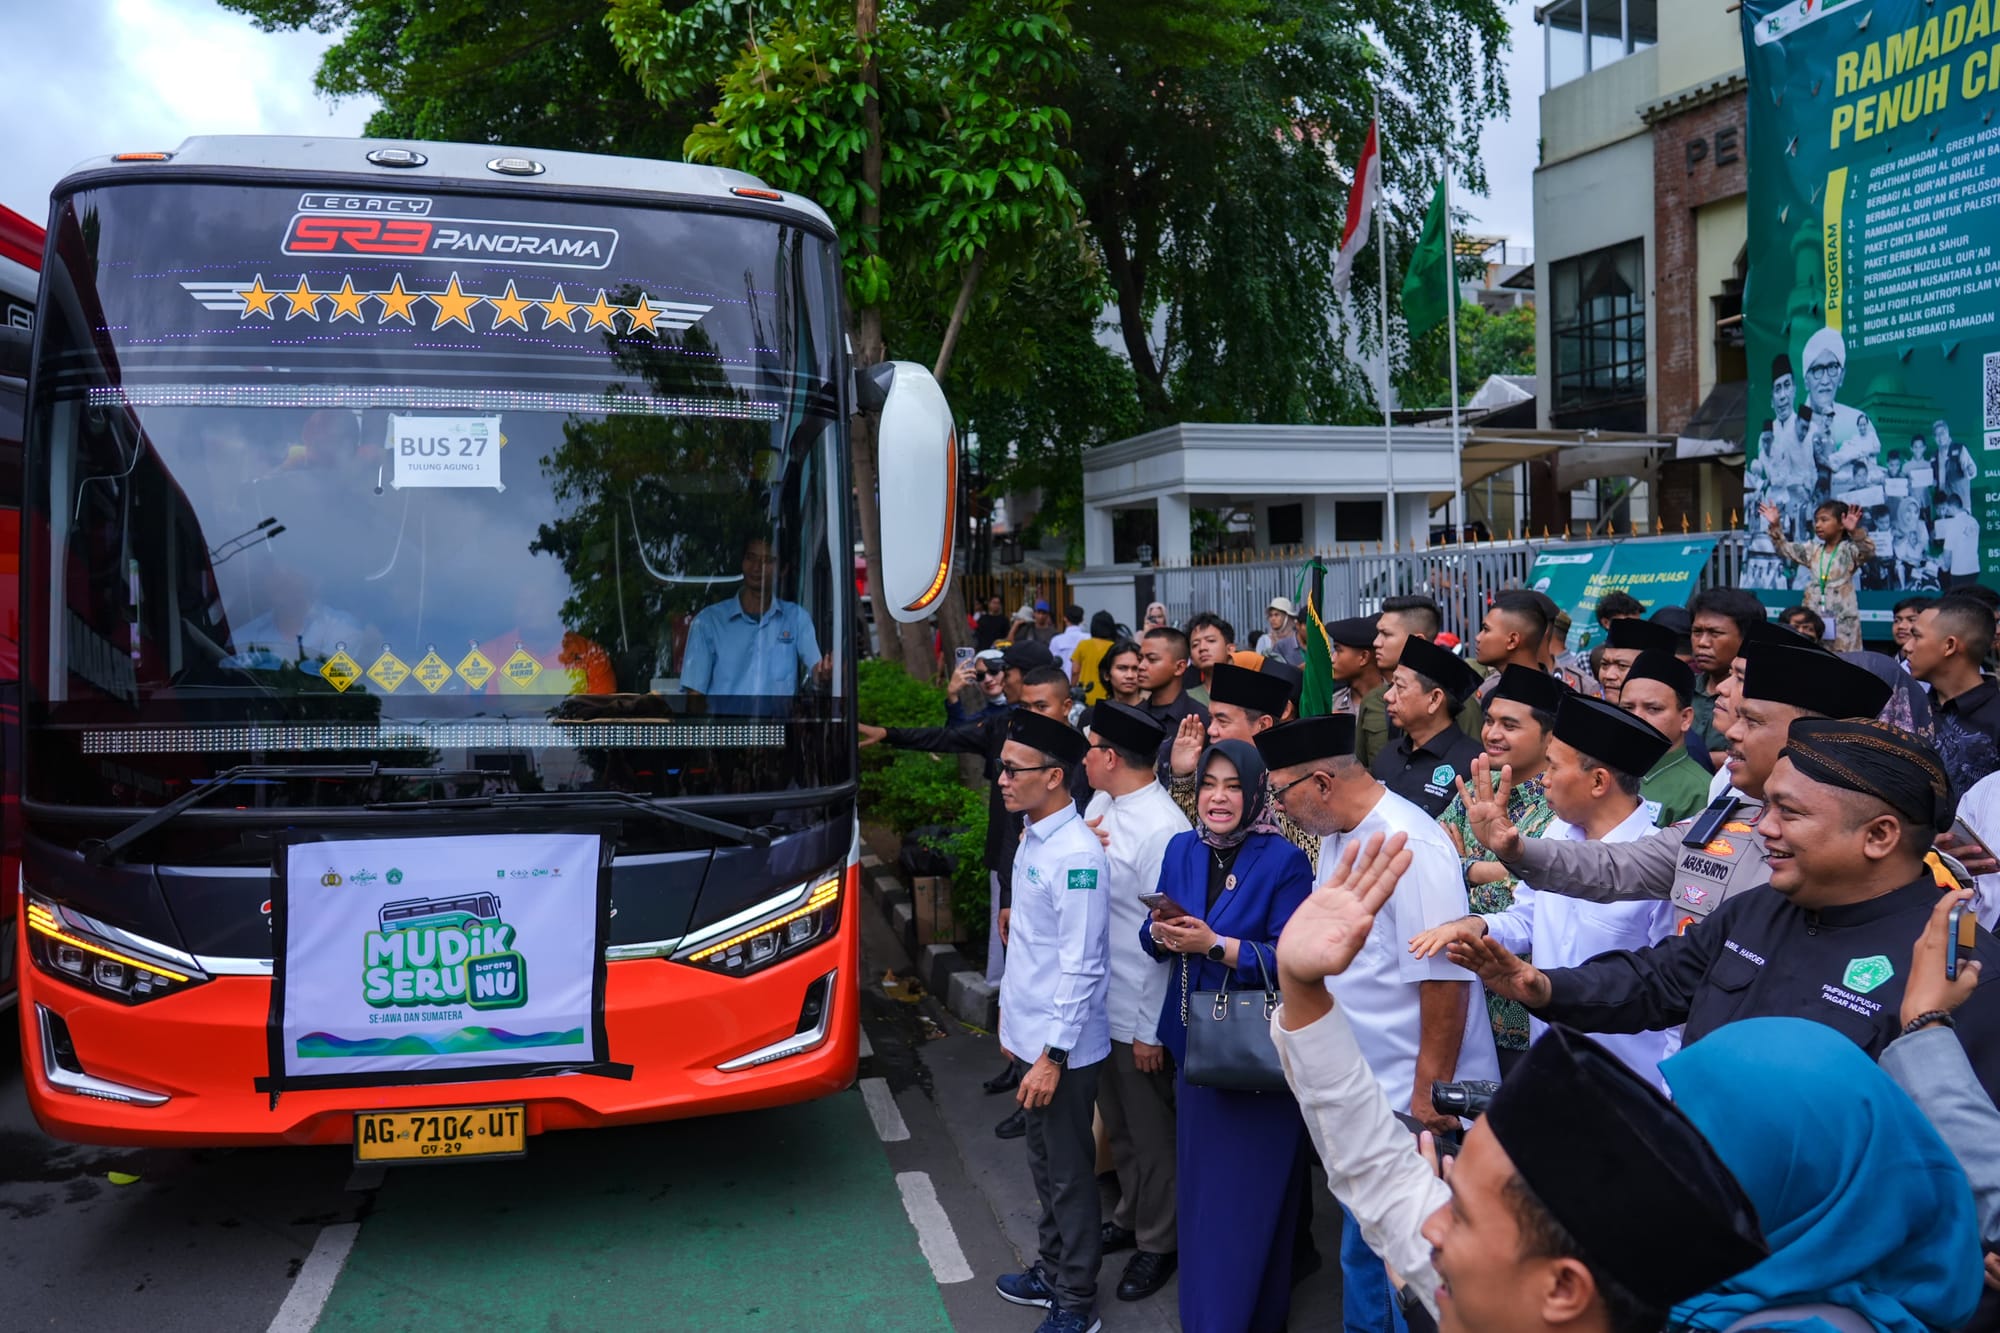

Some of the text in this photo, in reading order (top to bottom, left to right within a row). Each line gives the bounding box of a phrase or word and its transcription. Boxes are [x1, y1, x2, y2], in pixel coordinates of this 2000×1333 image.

[1831, 64, 1950, 150] PENUH
[1868, 171, 1910, 193] PELATIHAN
[1912, 165, 1936, 181] GURU
[1938, 160, 1949, 172] AL
[1951, 148, 1985, 167] QUR'AN
[1869, 162, 1896, 178] GREEN
[1897, 147, 1938, 168] RAMADAN
[1946, 134, 1975, 153] GREEN
[1866, 164, 1985, 209] BERBAGI AL QUR'AN BRAILLE
[305, 198, 424, 213] LEGACY
[1864, 220, 1904, 239] RAMADAN
[1906, 214, 1930, 228] CINTA
[1932, 203, 1962, 220] UNTUK
[1865, 204, 1899, 224] BERBAGI
[1900, 203, 1911, 214] AL
[1913, 191, 1946, 211] QUR'AN
[1948, 189, 1959, 202] KE
[432, 229, 601, 259] PANORAMA
[1864, 239, 1888, 255] PAKET
[1889, 233, 1913, 248] CINTA
[1915, 224, 1948, 242] IBADAH
[1864, 255, 1888, 270] PAKET
[1889, 246, 1928, 266] BERBUKA
[1939, 235, 1969, 253] SAHUR
[1828, 223, 1839, 310] PROGRAM
[1863, 289, 1877, 300] DAI
[1878, 279, 1919, 297] RAMADAN
[1920, 267, 1972, 287] NUSANTARA
[1975, 264, 1982, 276] &
[1864, 265, 1912, 285] PERINGATAN
[1914, 256, 1953, 273] NUZULUL
[1955, 246, 1991, 263] QUR'AN
[1863, 302, 1886, 316] NGAJI
[1911, 285, 1961, 306] FILANTROPI
[1963, 279, 1992, 295] ISLAM
[1863, 317, 1889, 331] MUDIK
[1899, 309, 1922, 324] BALIK
[1924, 303, 1956, 319] GRATIS
[1863, 330, 1905, 346] BINGKISAN
[1907, 321, 1947, 338] SEMBAKO
[1949, 312, 1995, 329] RAMADAN
[400, 437, 488, 457] BUS 27
[408, 463, 442, 471] TULUNG
[443, 463, 474, 471] AGUNG
[1681, 854, 1729, 880] AGUS SURYO
[366, 965, 466, 1000] SERU
[475, 971, 516, 998] NU
[369, 1010, 463, 1024] SE-JAWA DAN SUMATERA
[1822, 992, 1871, 1017] PAGAR NUSA
[1855, 996, 1882, 1012] PUSAT
[363, 1112, 519, 1144] AG 7104 UT
